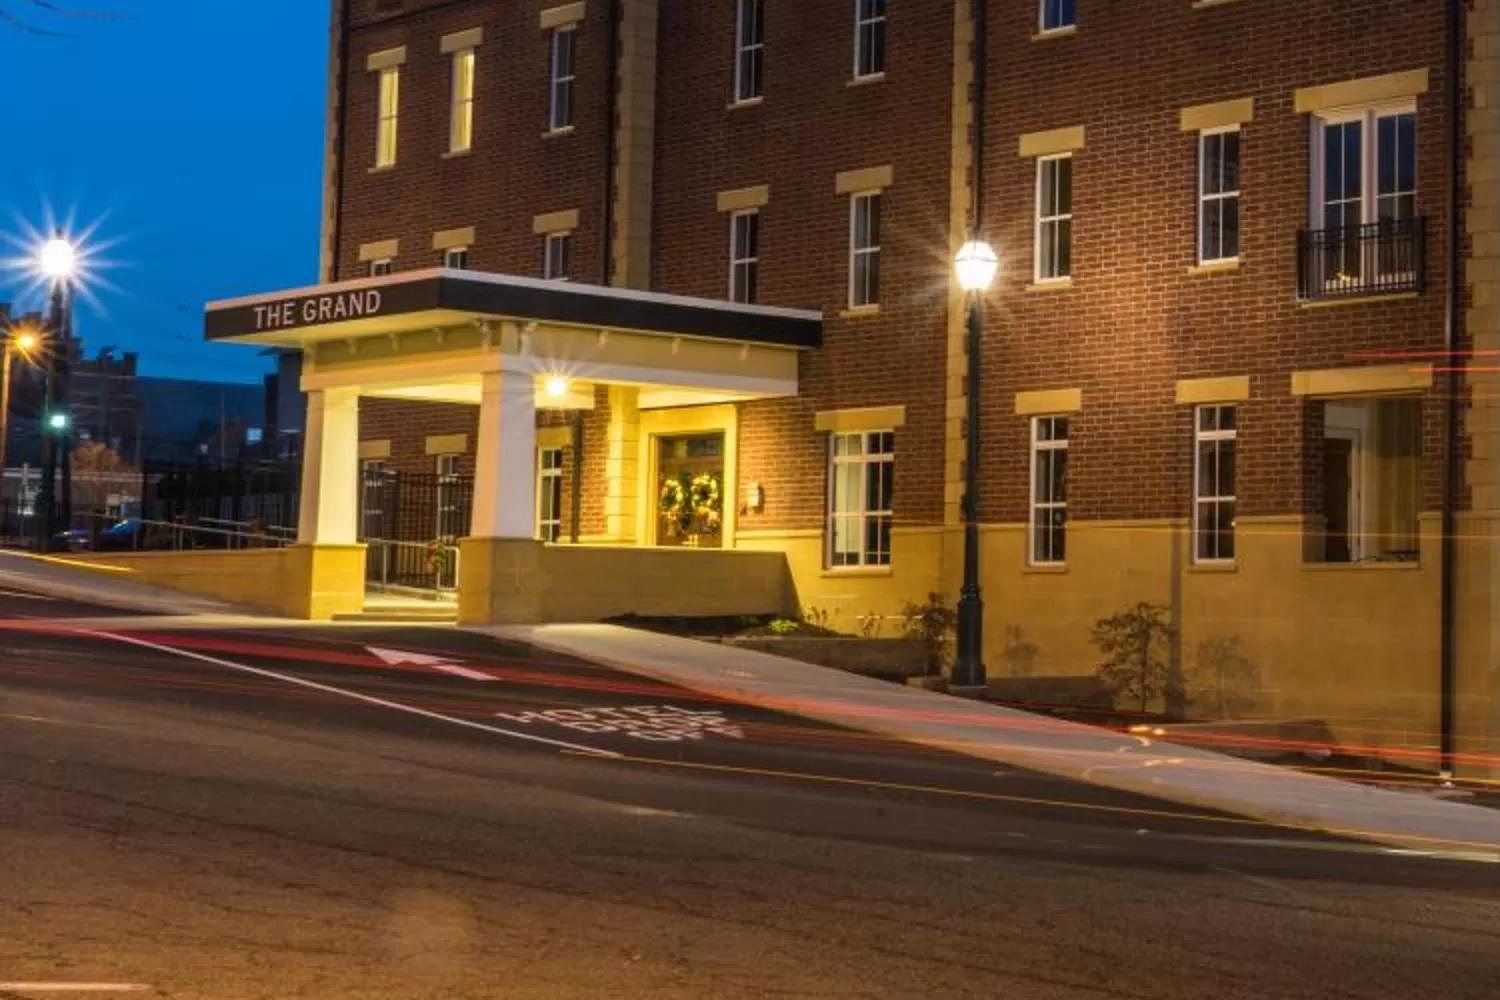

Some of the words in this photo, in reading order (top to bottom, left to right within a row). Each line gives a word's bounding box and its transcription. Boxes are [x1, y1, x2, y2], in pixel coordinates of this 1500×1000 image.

[253, 301, 296, 329] THE
[303, 290, 381, 322] GRAND
[496, 705, 723, 723] HOTEL
